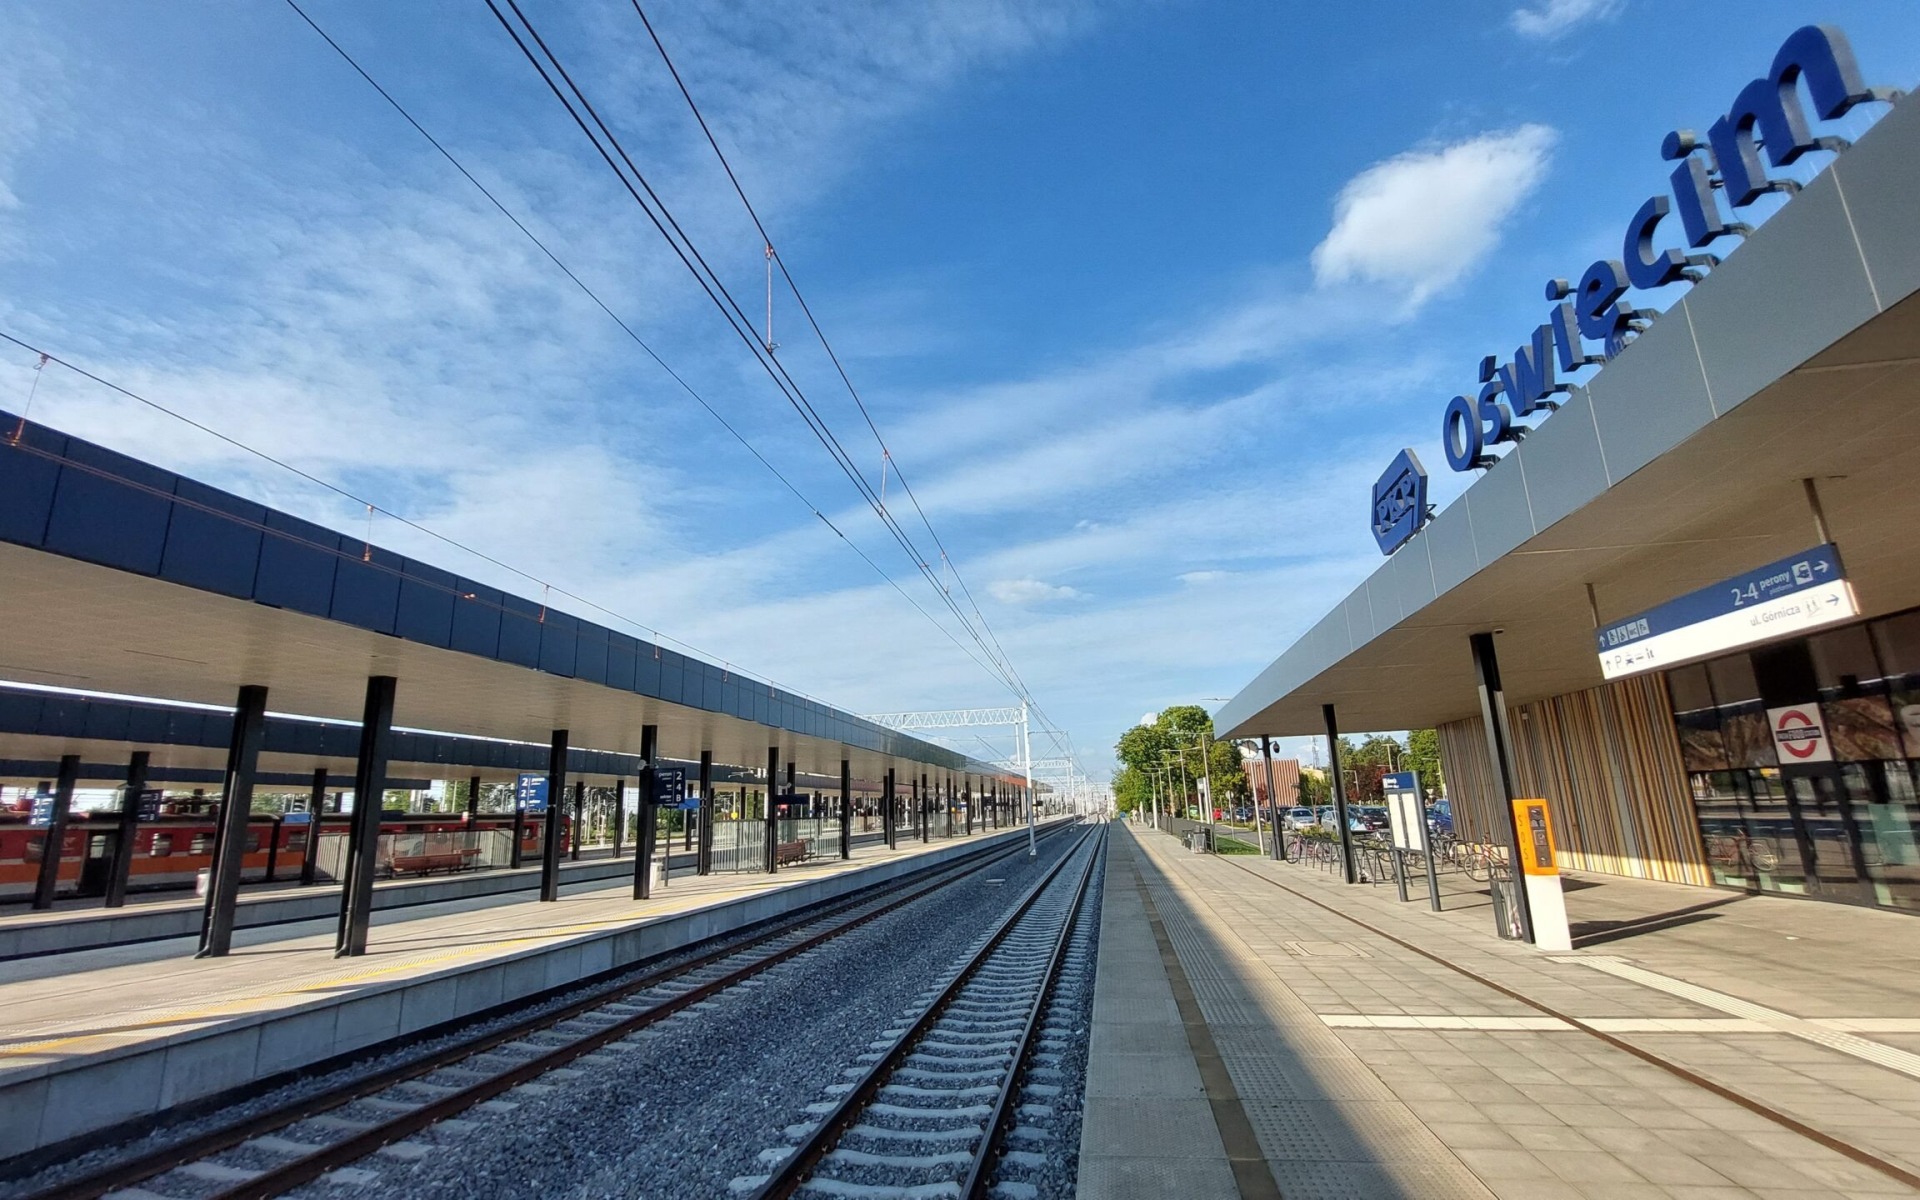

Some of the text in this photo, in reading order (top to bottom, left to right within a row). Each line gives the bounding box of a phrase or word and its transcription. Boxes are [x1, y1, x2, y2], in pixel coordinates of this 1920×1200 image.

[1443, 25, 1866, 471] Oświęcim
[1376, 473, 1415, 533] PKP
[1731, 571, 1790, 606] 2-4 perony
[1750, 605, 1801, 626] ul. Górnicza
[522, 777, 528, 786] 2
[676, 772, 682, 780] 2
